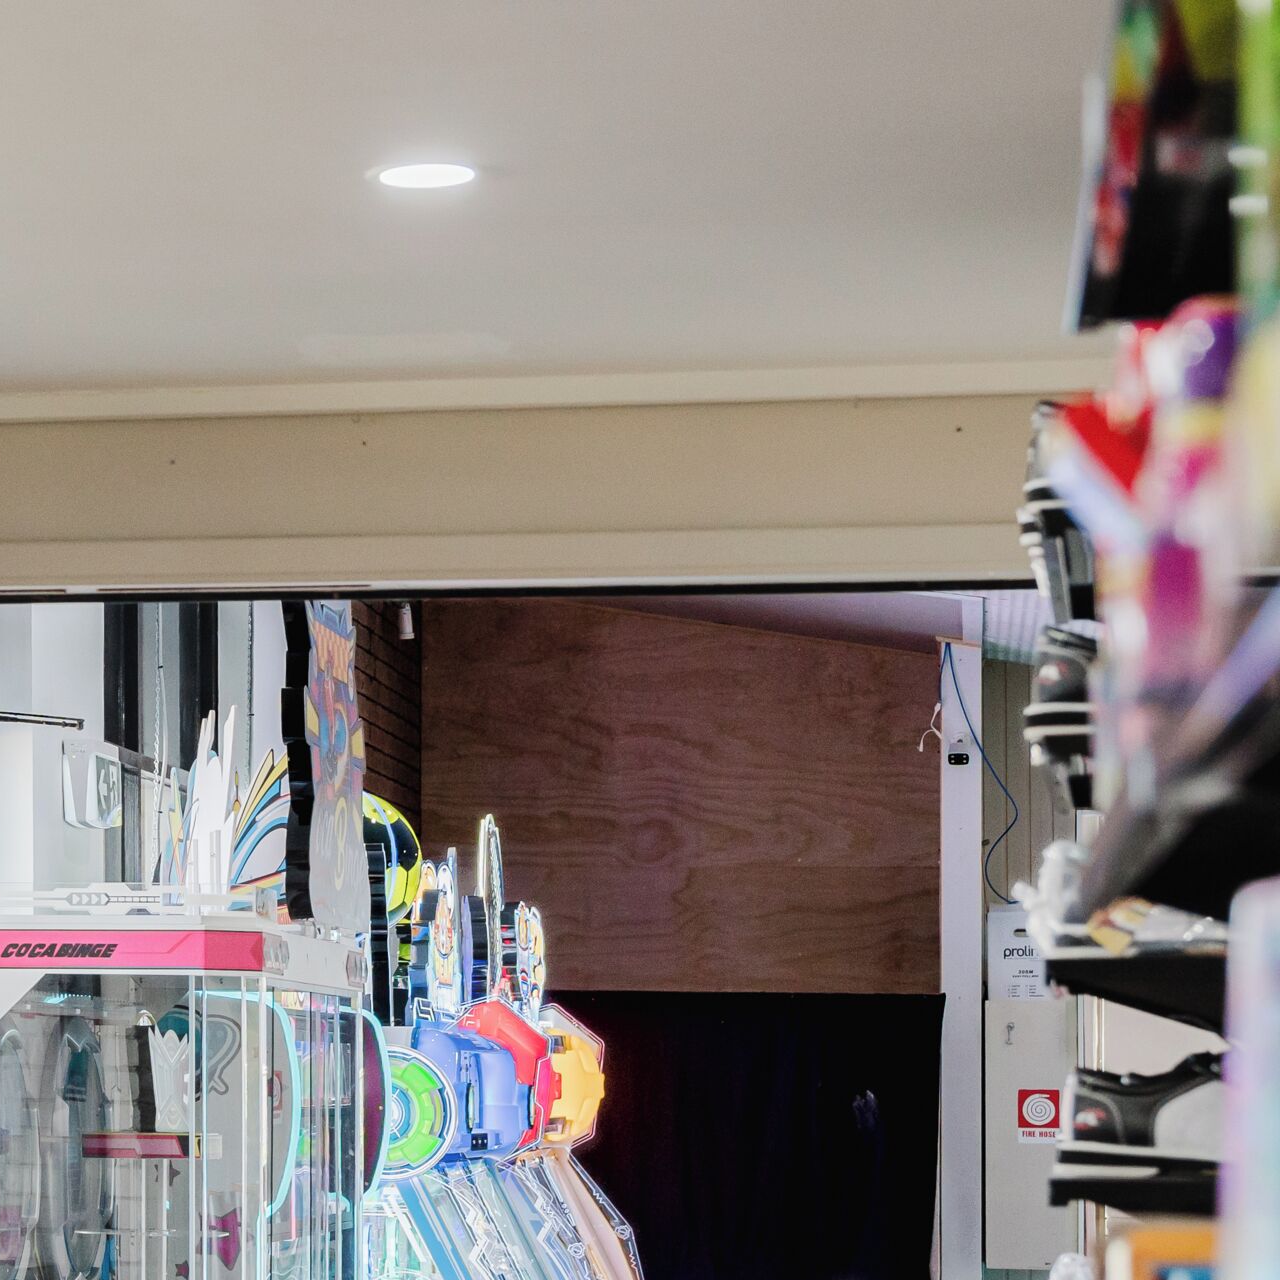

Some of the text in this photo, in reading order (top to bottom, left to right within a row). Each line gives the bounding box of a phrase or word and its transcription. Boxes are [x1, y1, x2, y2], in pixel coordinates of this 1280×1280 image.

[0, 943, 118, 958] COCABINGE
[1022, 1130, 1056, 1138] FIRE HOSE
